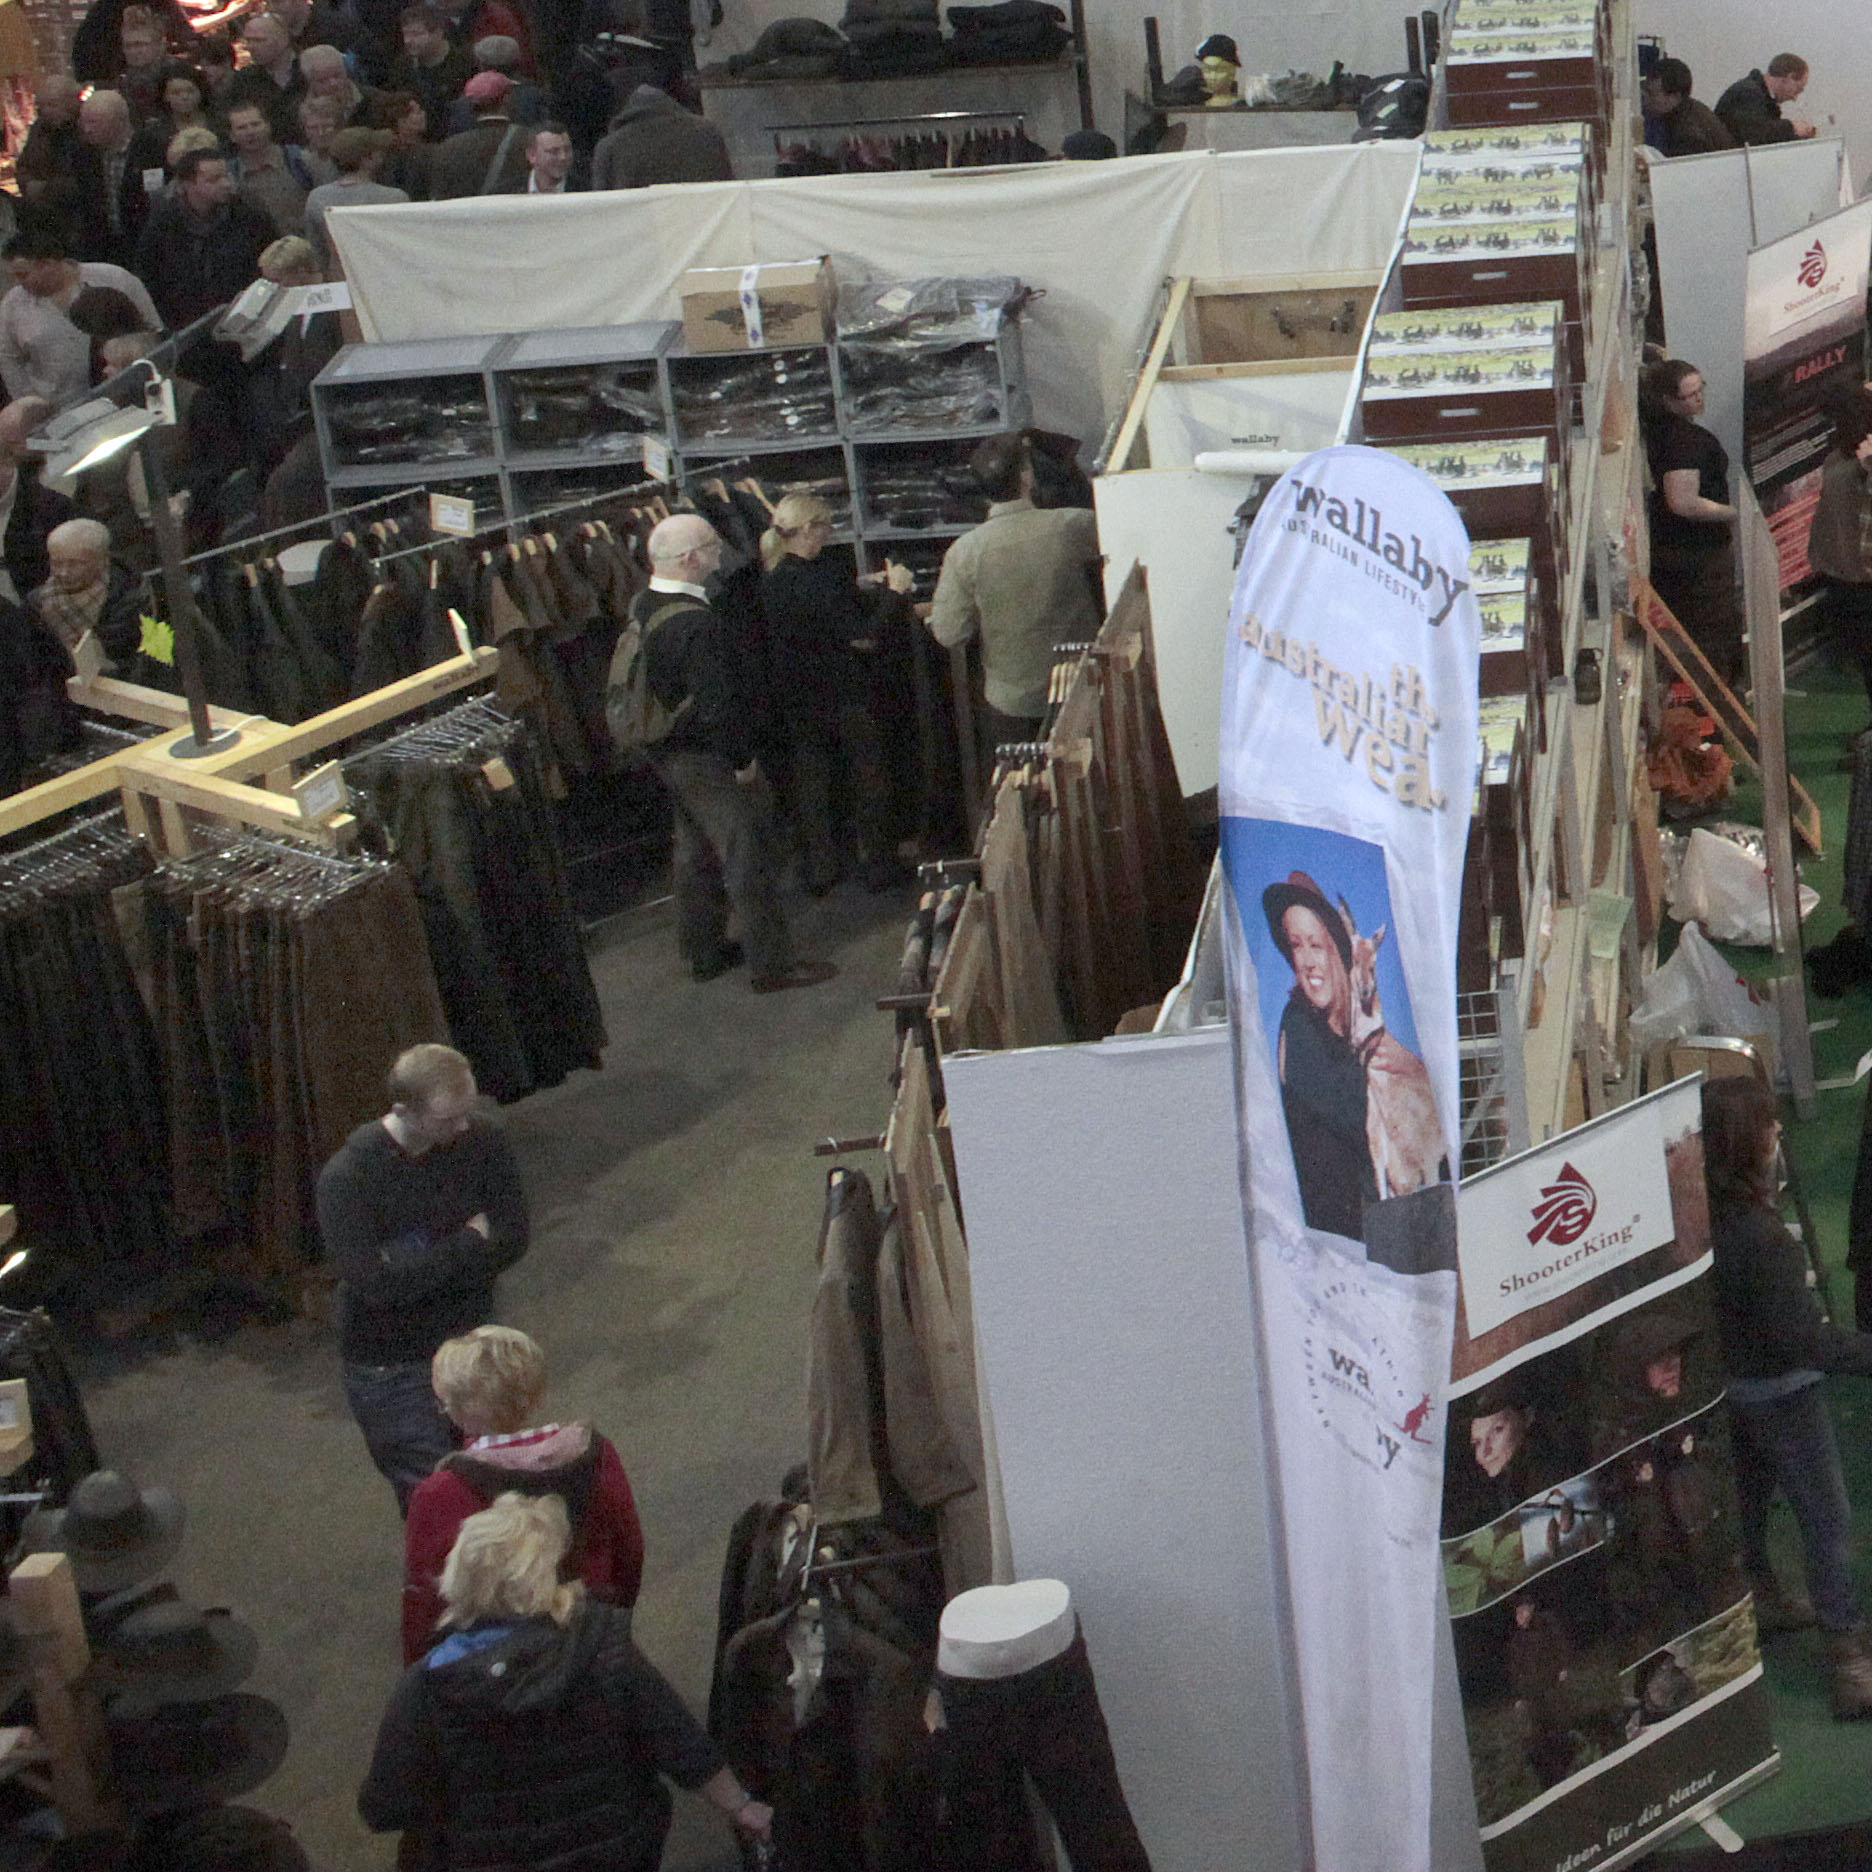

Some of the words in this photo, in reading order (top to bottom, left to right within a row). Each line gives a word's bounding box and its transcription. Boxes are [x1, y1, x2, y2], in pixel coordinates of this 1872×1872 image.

[1231, 433, 1279, 447] wallaby
[1290, 478, 1469, 627] wallaby
[1499, 1224, 1633, 1298] ShooterKing
[1667, 1769, 1716, 1809] Natur
